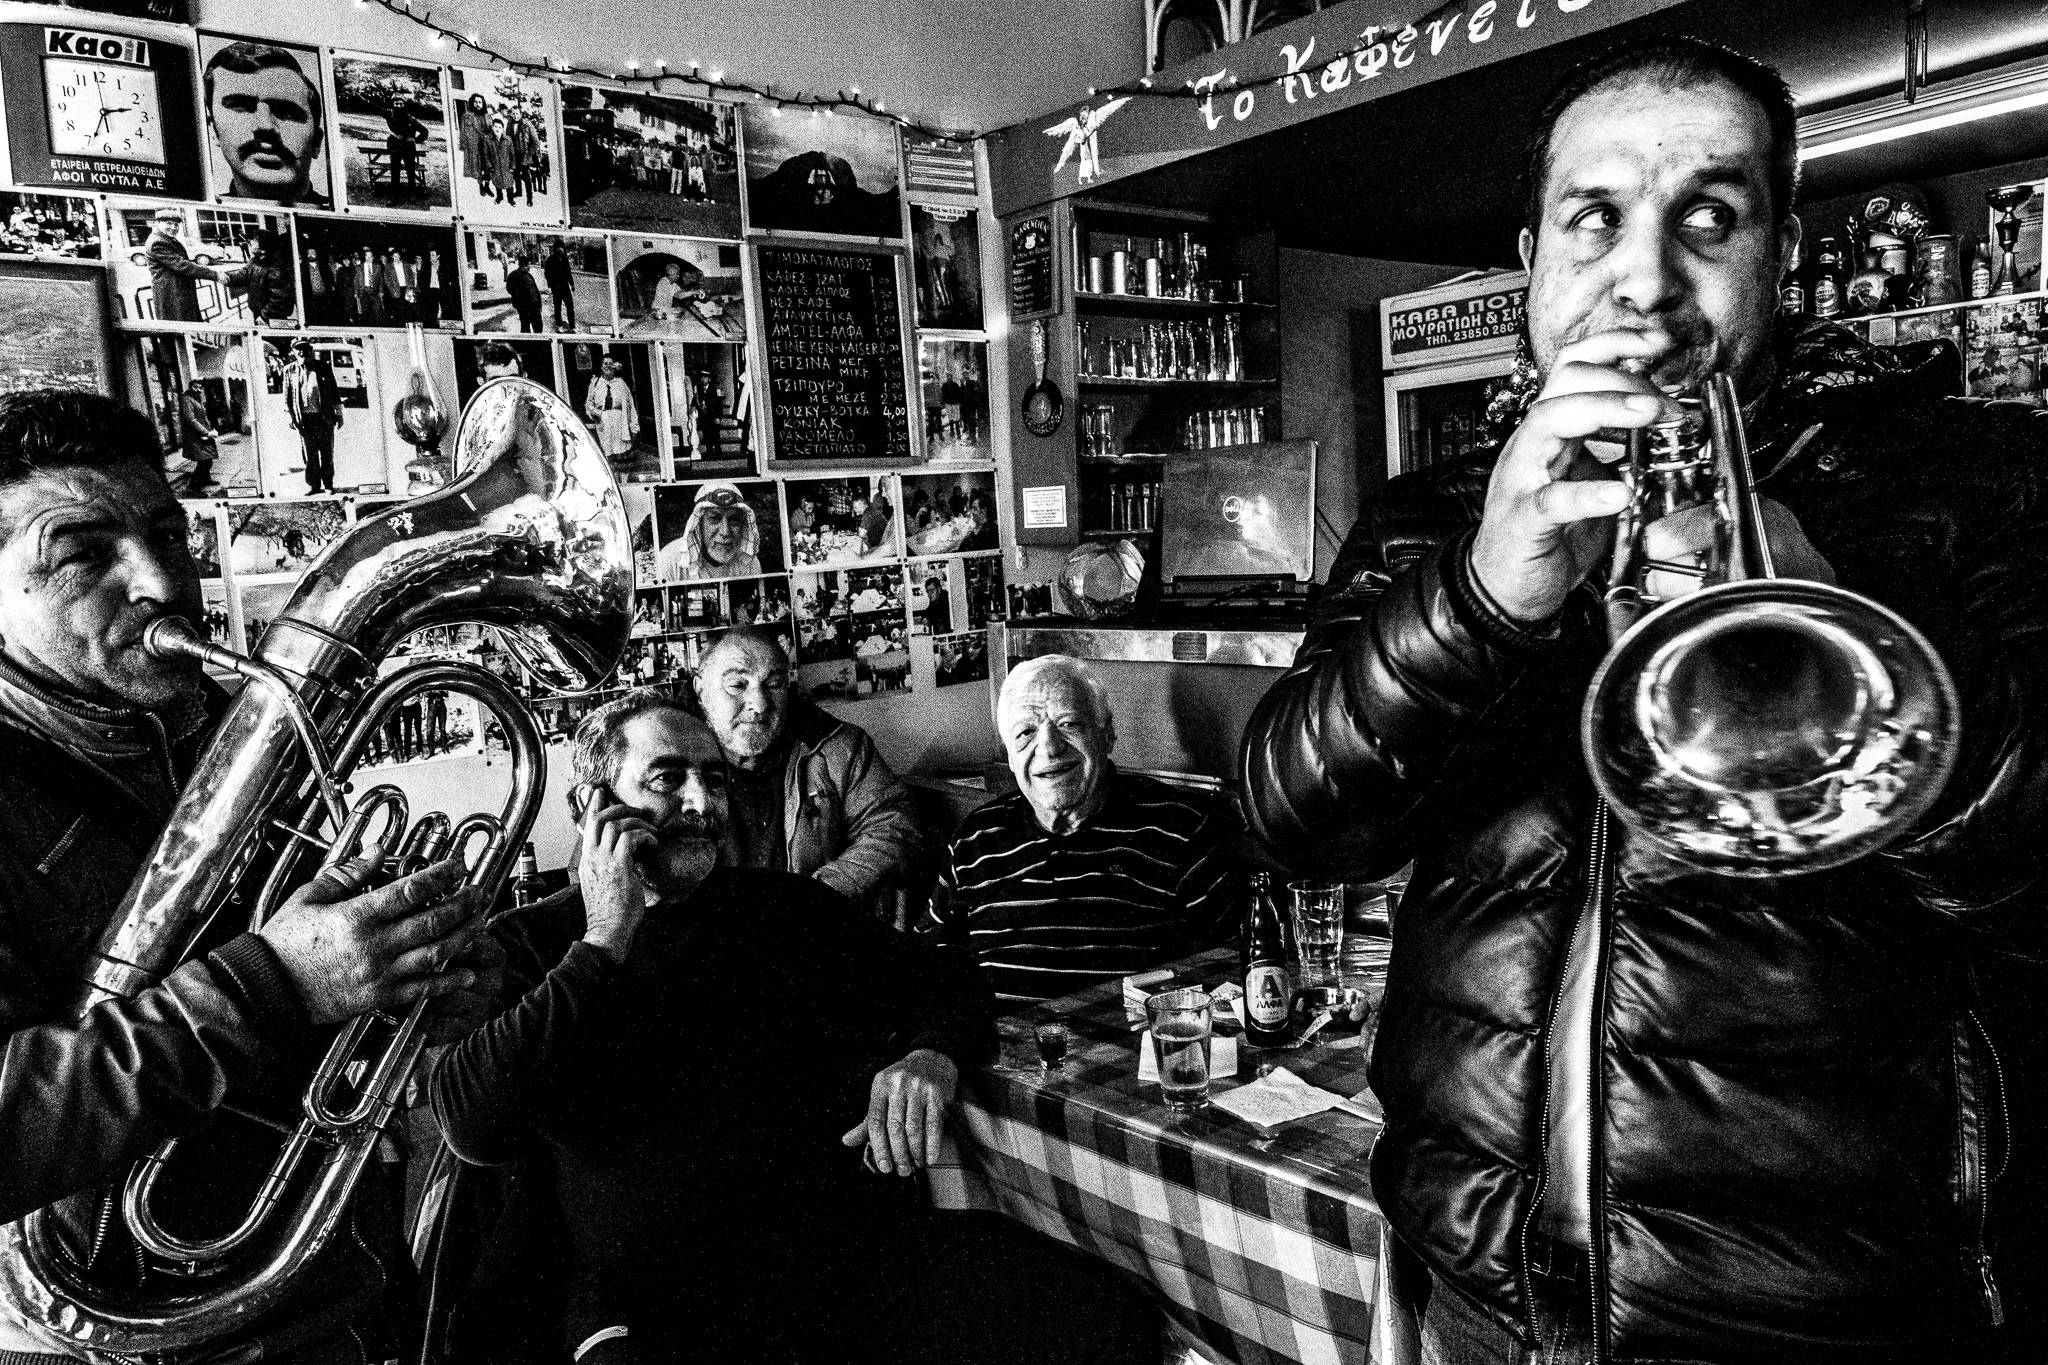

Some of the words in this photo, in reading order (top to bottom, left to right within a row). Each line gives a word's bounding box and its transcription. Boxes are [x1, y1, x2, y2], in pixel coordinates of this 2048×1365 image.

[48, 30, 149, 63] Kaoil
[75, 74, 87, 86] 11
[93, 71, 106, 83] 12
[62, 85, 76, 97] 10
[116, 79, 122, 90] 1
[131, 92, 140, 105] 2
[1194, 67, 1255, 131] Το
[58, 102, 67, 113] 9
[140, 111, 149, 123] 3
[66, 119, 76, 131] 8
[134, 127, 144, 139] 4
[84, 134, 92, 146] 7
[123, 138, 132, 150] 5
[103, 142, 112, 154] 6
[50, 158, 91, 171] ΕΤΑΙΡΕΙΑ
[94, 162, 166, 178] ΠΕΤΡΕΛΑΙΟΕΙΔΩΝ
[52, 170, 85, 182] ΑΦΟΙ
[91, 173, 140, 187] ΚΟΥΤΛΑ
[1391, 304, 1458, 328] ΚΑΒΑ
[1485, 311, 1498, 325] &
[1453, 326, 1490, 341] 23850
[771, 355, 831, 370] ΡΕΤΣΙΝΑ
[773, 378, 844, 393] ΤΣΙΠΟΥΡΟ
[882, 405, 906, 420] 4,00
[783, 417, 843, 430] ΚΟΝΙΑΚ
[779, 429, 855, 442] ΡΑΚΟΜΕΛΟ
